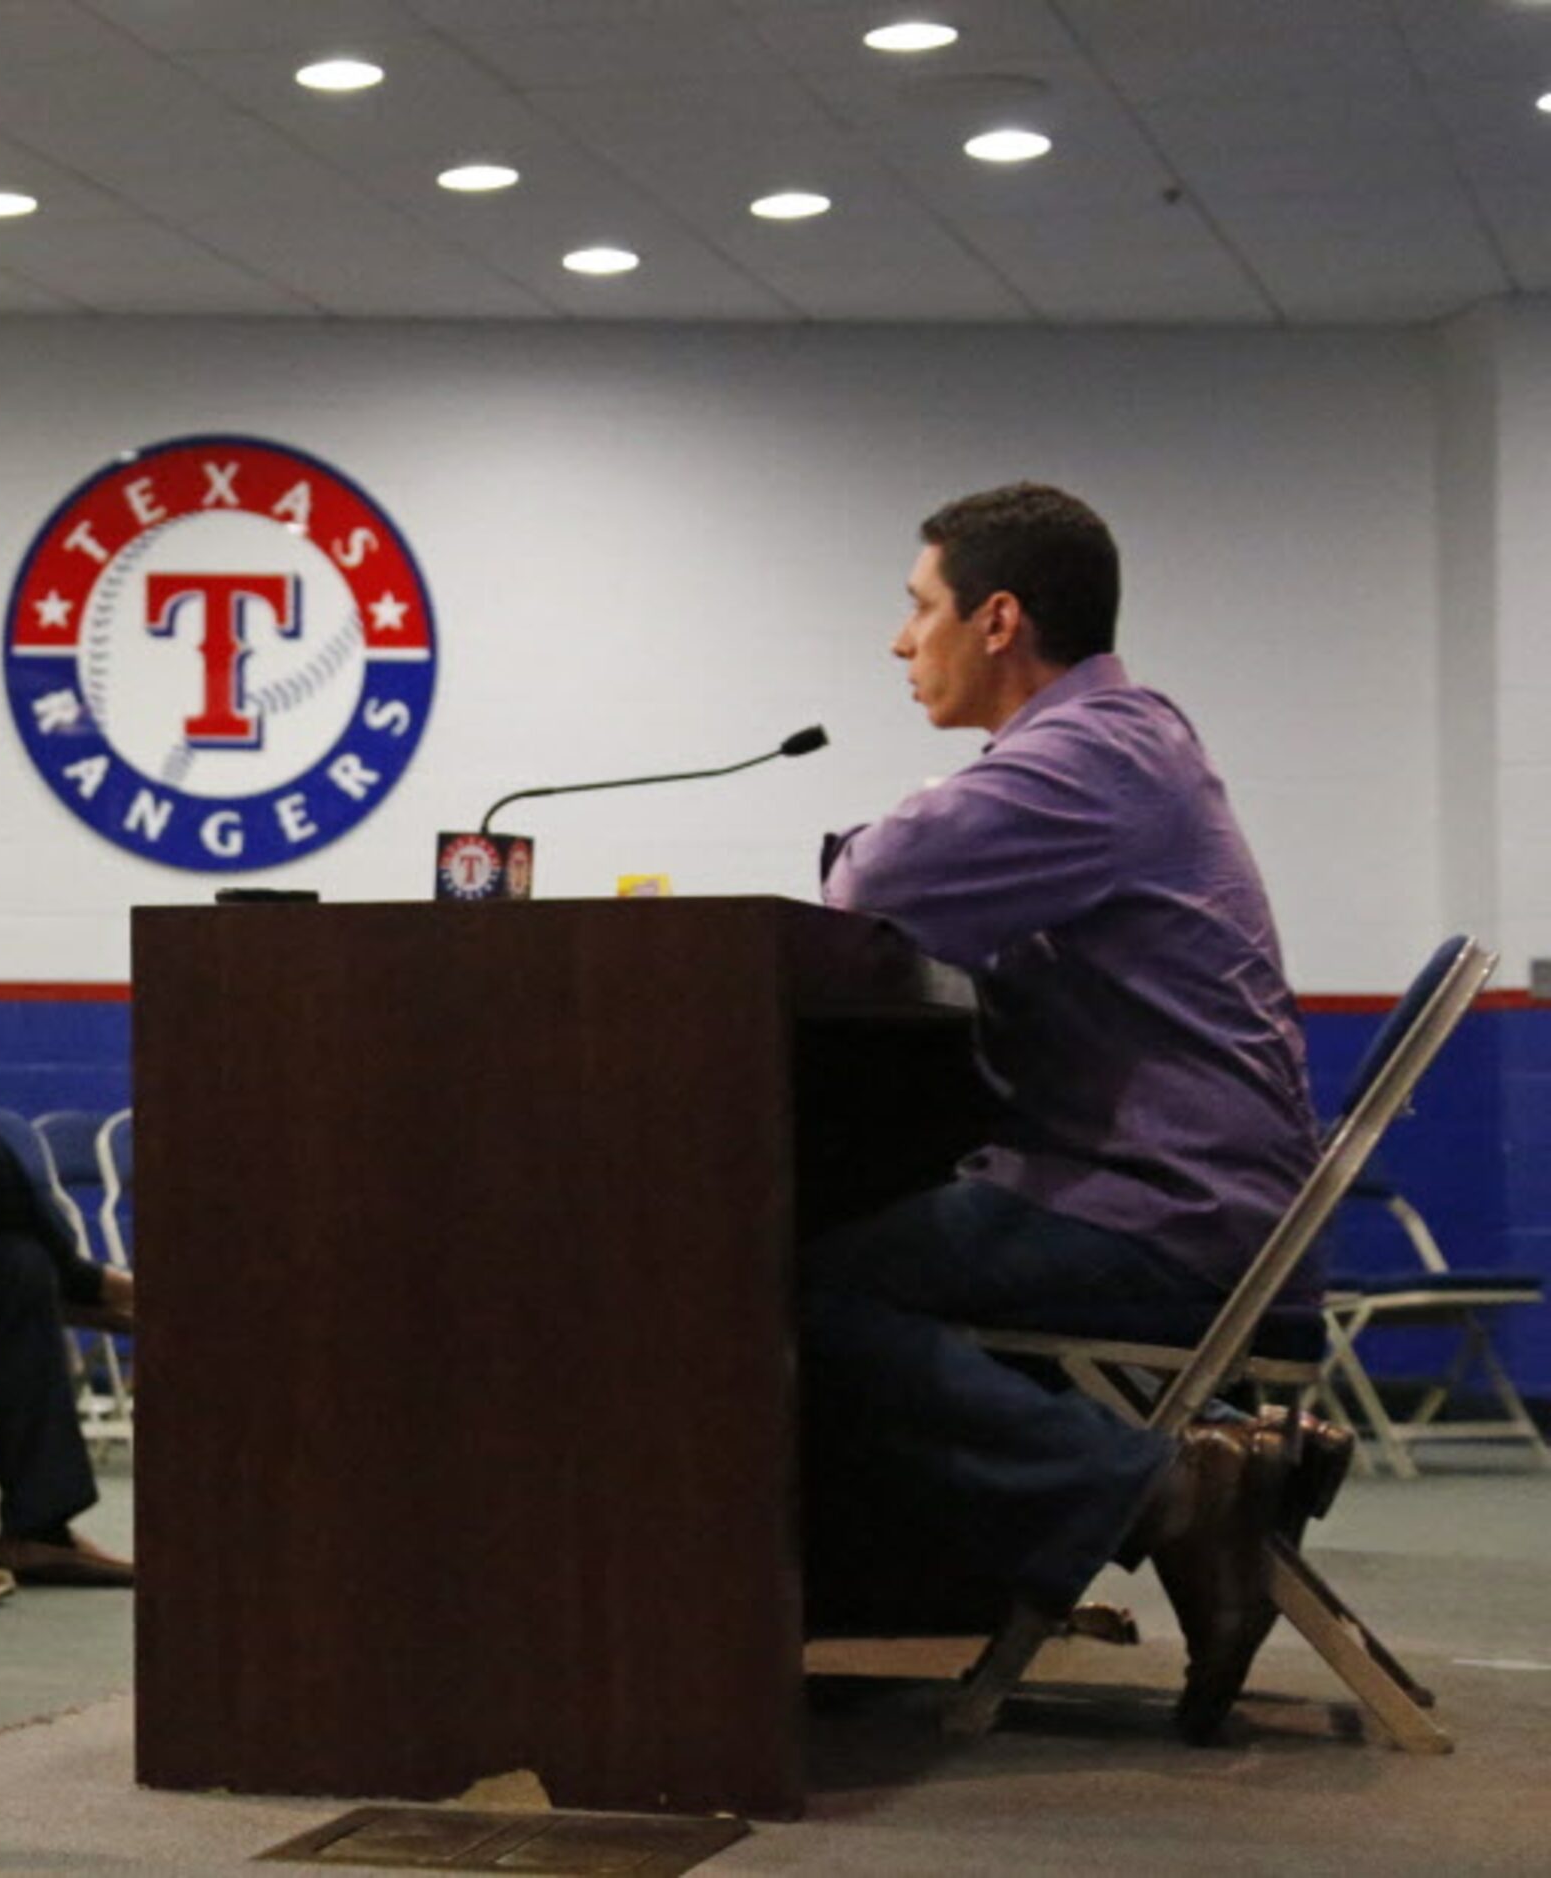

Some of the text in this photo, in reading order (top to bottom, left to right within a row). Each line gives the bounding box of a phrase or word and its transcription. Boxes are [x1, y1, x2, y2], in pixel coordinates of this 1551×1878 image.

[63, 461, 379, 564] TEXAS
[145, 572, 302, 751] T
[32, 688, 411, 857] RANGERS
